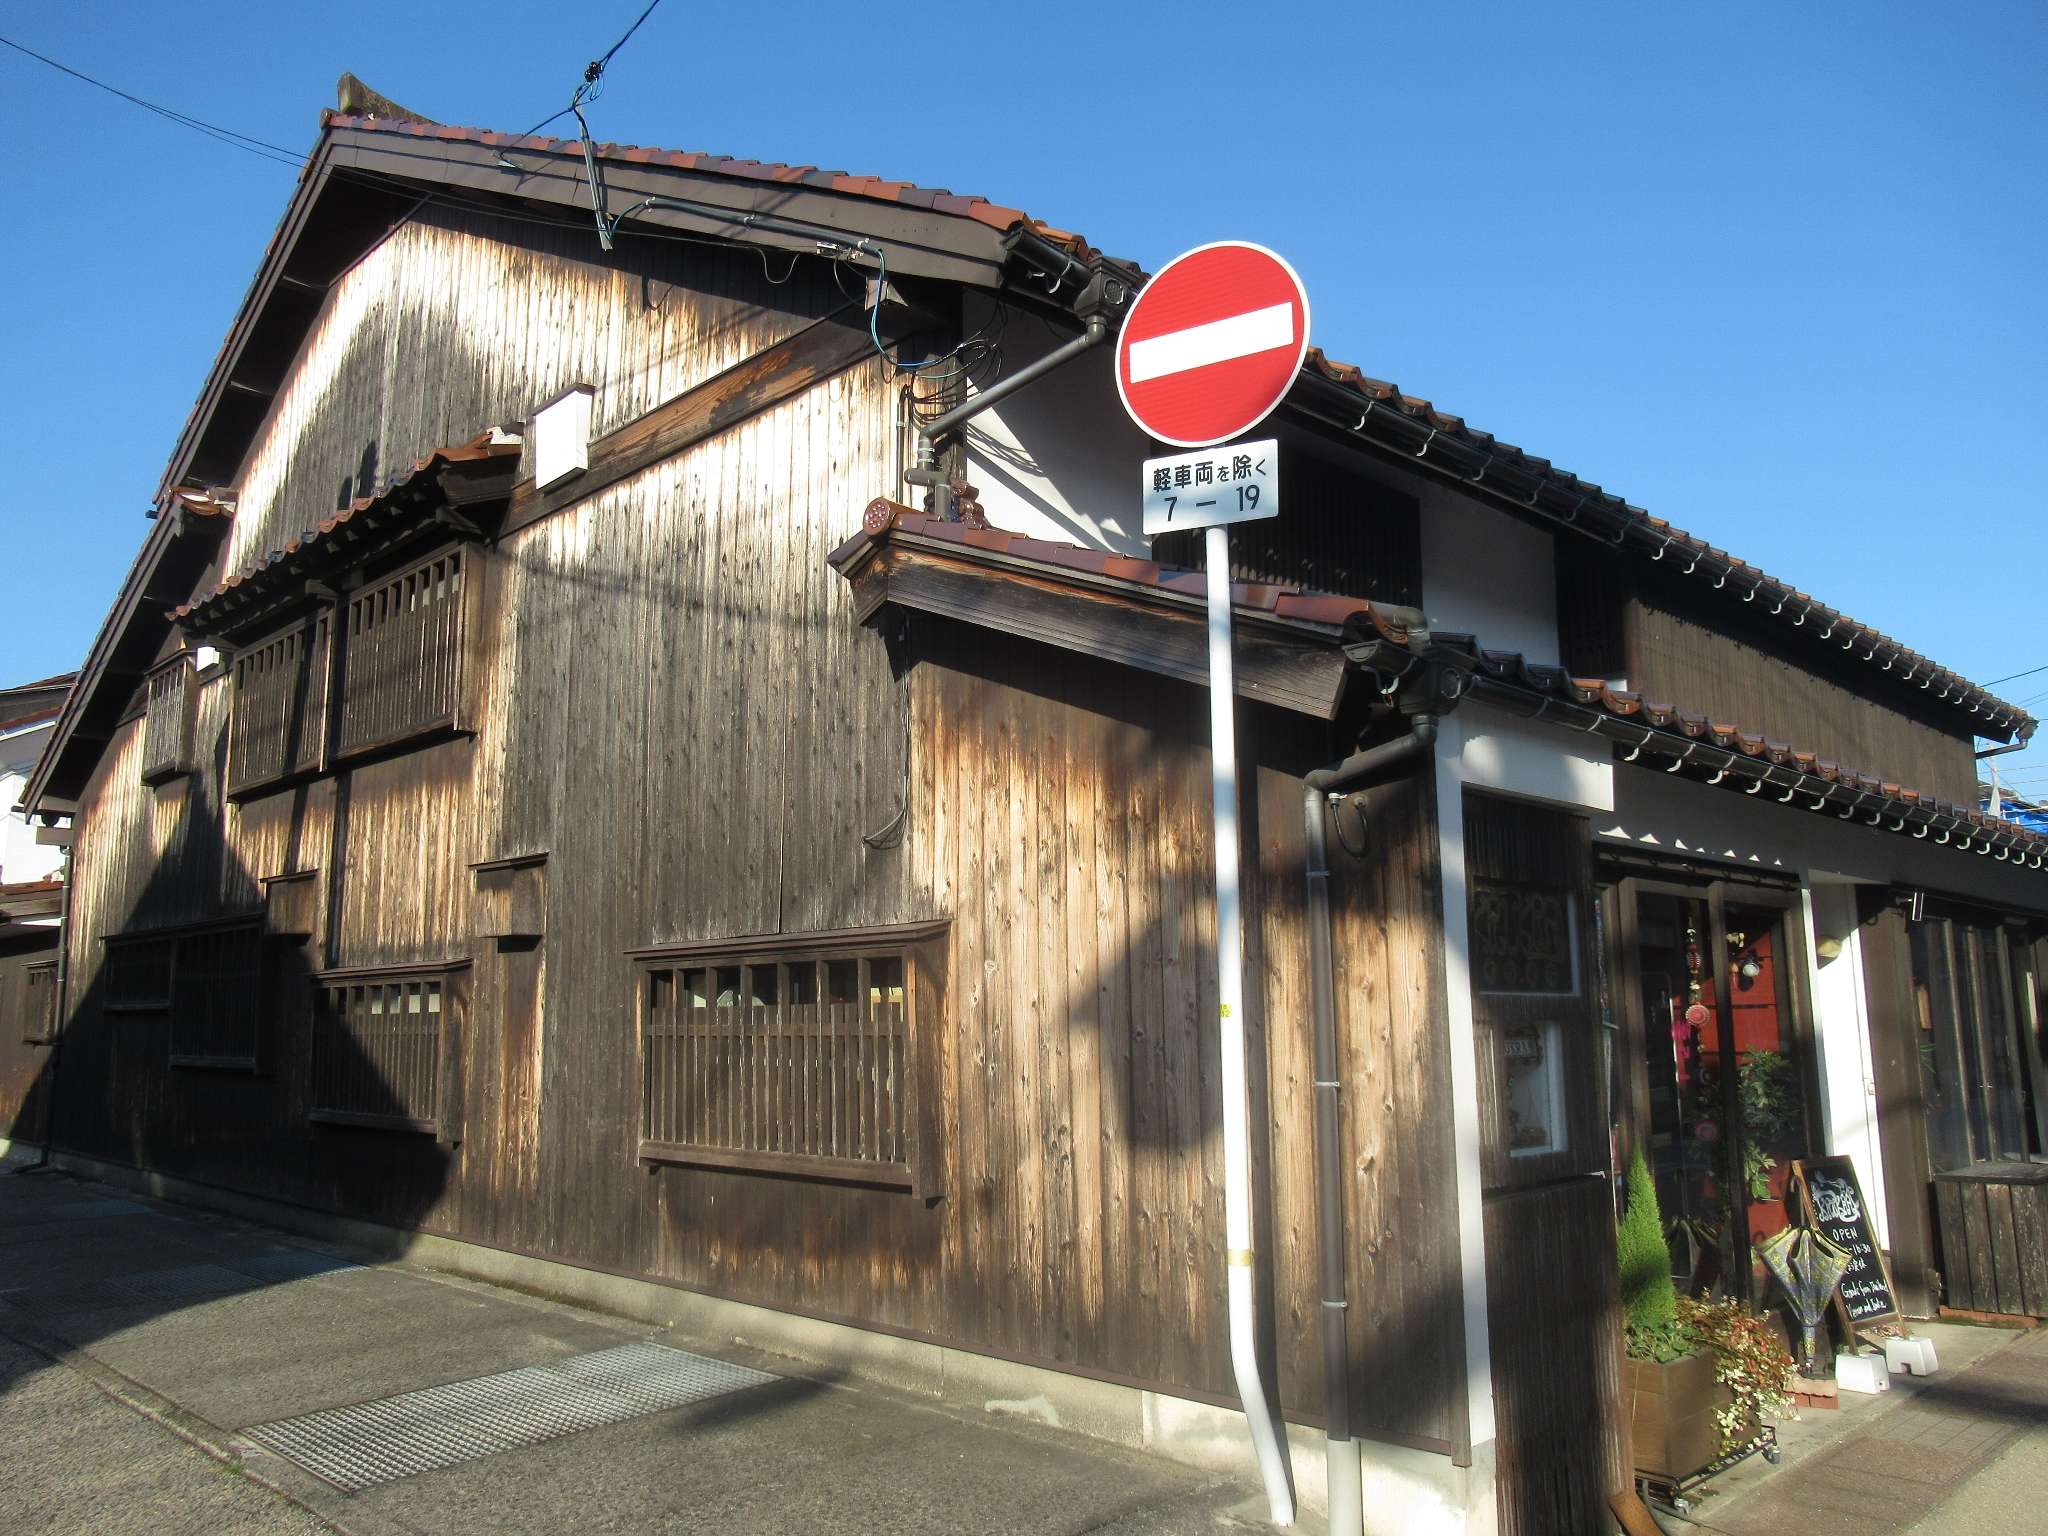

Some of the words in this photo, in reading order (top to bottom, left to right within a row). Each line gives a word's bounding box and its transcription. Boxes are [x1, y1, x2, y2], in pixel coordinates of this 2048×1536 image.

[1153, 454, 1266, 492] 軽車両を除く
[1832, 1226, 1858, 1241] OPEN
